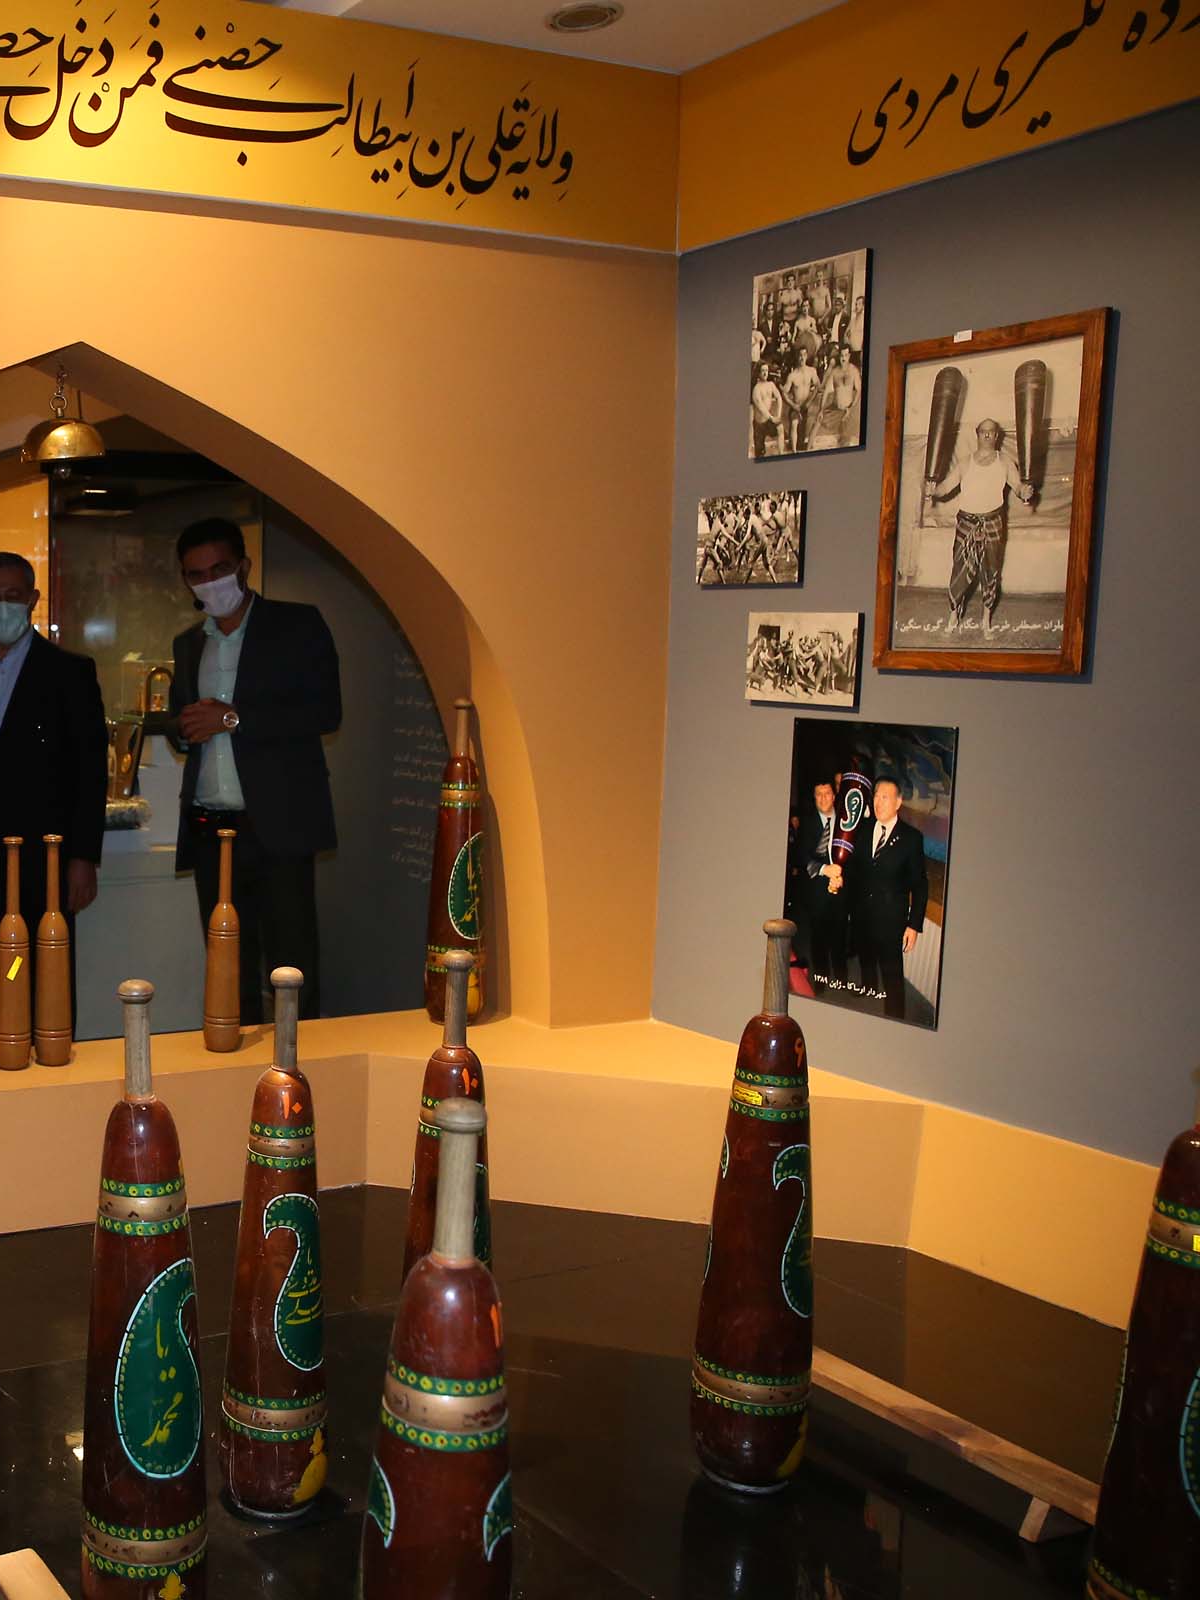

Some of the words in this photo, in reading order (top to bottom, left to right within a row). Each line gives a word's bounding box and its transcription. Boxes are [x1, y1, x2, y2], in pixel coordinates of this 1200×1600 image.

[4, 17, 114, 140] دخل
[68, 12, 164, 147] فمن
[847, 73, 959, 166] مردی
[409, 127, 465, 196] بن
[829, 979, 842, 990] ژاپن
[866, 987, 887, 999] شهردار
